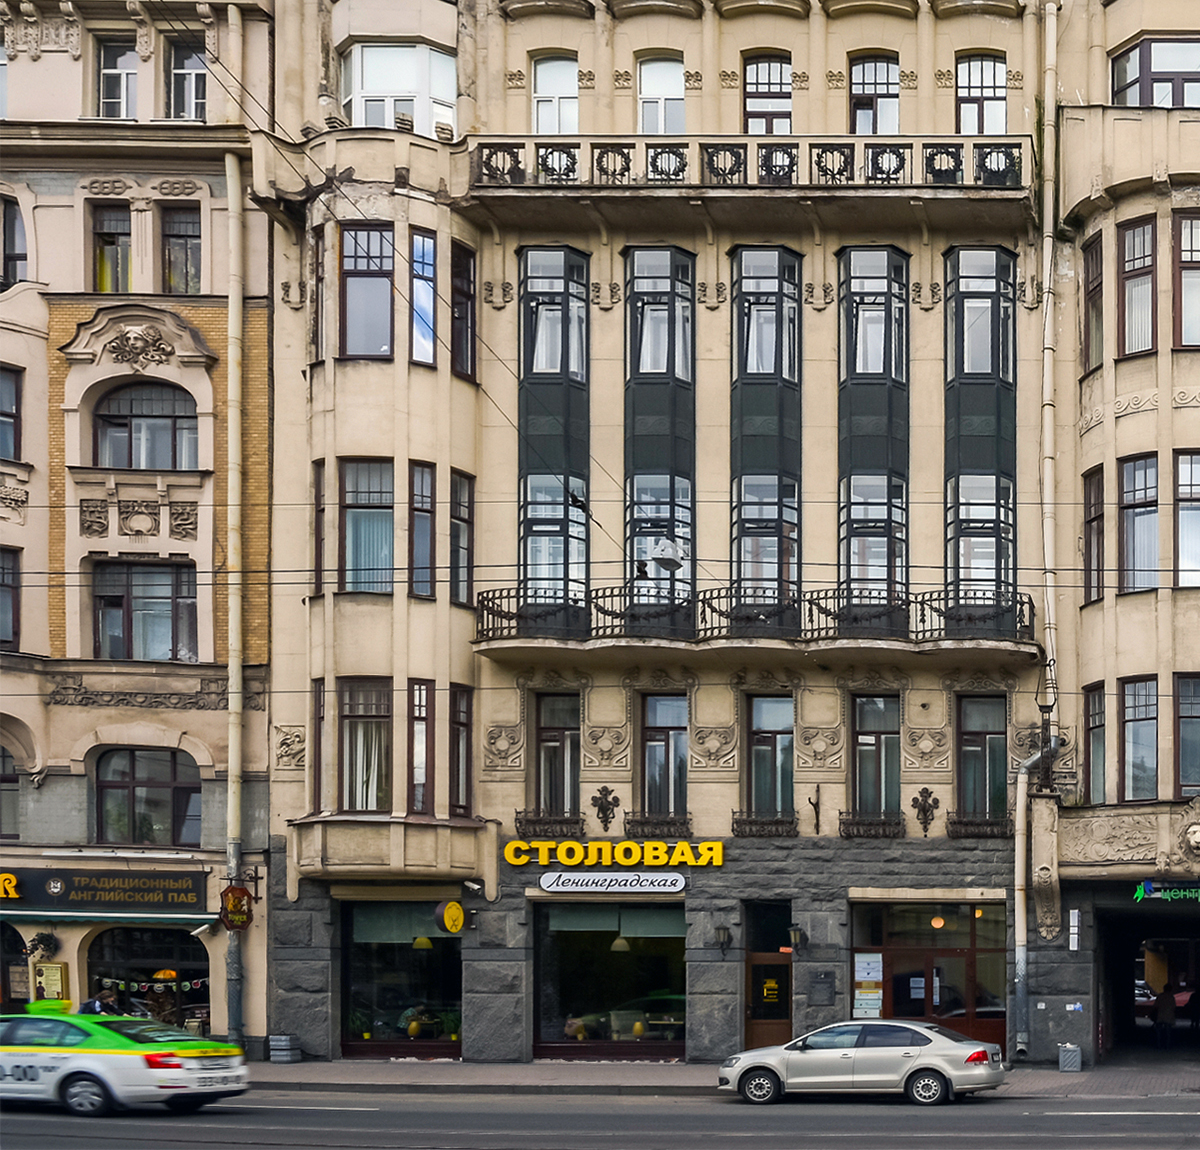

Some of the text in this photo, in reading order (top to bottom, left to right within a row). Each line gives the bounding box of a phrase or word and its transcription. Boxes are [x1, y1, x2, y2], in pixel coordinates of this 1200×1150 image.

[503, 840, 724, 867] СТОЛОВАЯ
[72, 876, 193, 890] ТРАДИЦИОННЫЙ
[546, 873, 680, 891] Ленинградская
[69, 890, 198, 903] АНГЛИЙСКИЙ ПАБ
